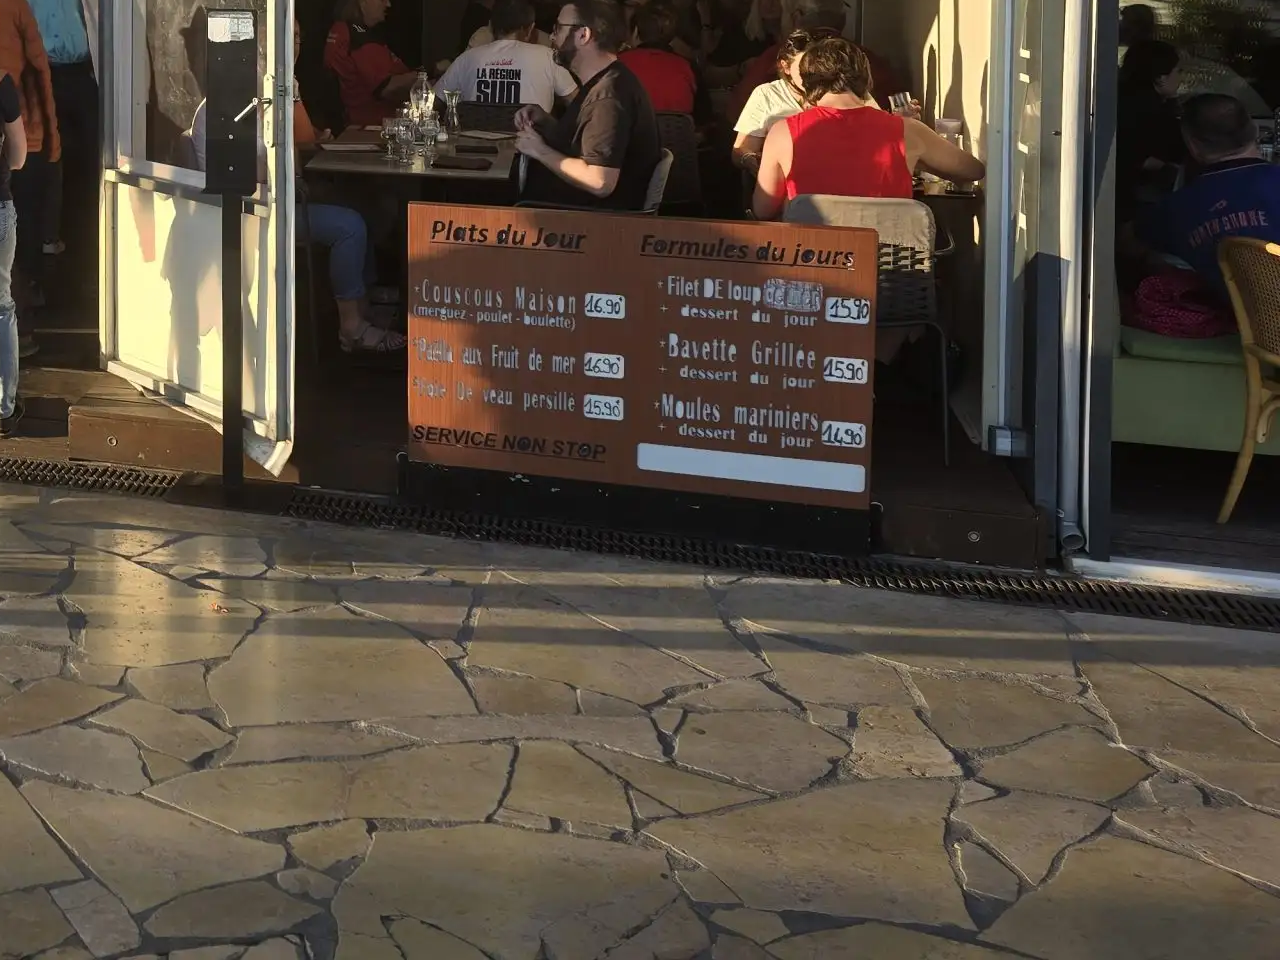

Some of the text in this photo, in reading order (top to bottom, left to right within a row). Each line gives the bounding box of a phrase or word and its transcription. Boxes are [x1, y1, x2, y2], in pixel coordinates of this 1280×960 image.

[476, 68, 488, 79] LA
[476, 80, 521, 104] SUD
[431, 220, 587, 250] Plats du Jour
[640, 234, 854, 267] Formules du jours
[422, 279, 576, 314] Couscous Maison
[668, 275, 700, 298] Filet
[704, 277, 723, 299] DE
[728, 279, 762, 306] loup
[476, 310, 513, 324] poulet
[681, 303, 818, 328] dessert du jour
[462, 347, 483, 366] aux
[491, 344, 520, 369] Fruit
[528, 348, 543, 371] de
[552, 355, 576, 374] mer
[668, 333, 816, 369] Bavette Grillée
[680, 365, 816, 389] dessert du jour
[483, 388, 513, 405] veau
[661, 393, 819, 432] Moules mariniers
[413, 424, 607, 460] SERVICE NON STOP
[679, 423, 814, 448] dessert du jour
